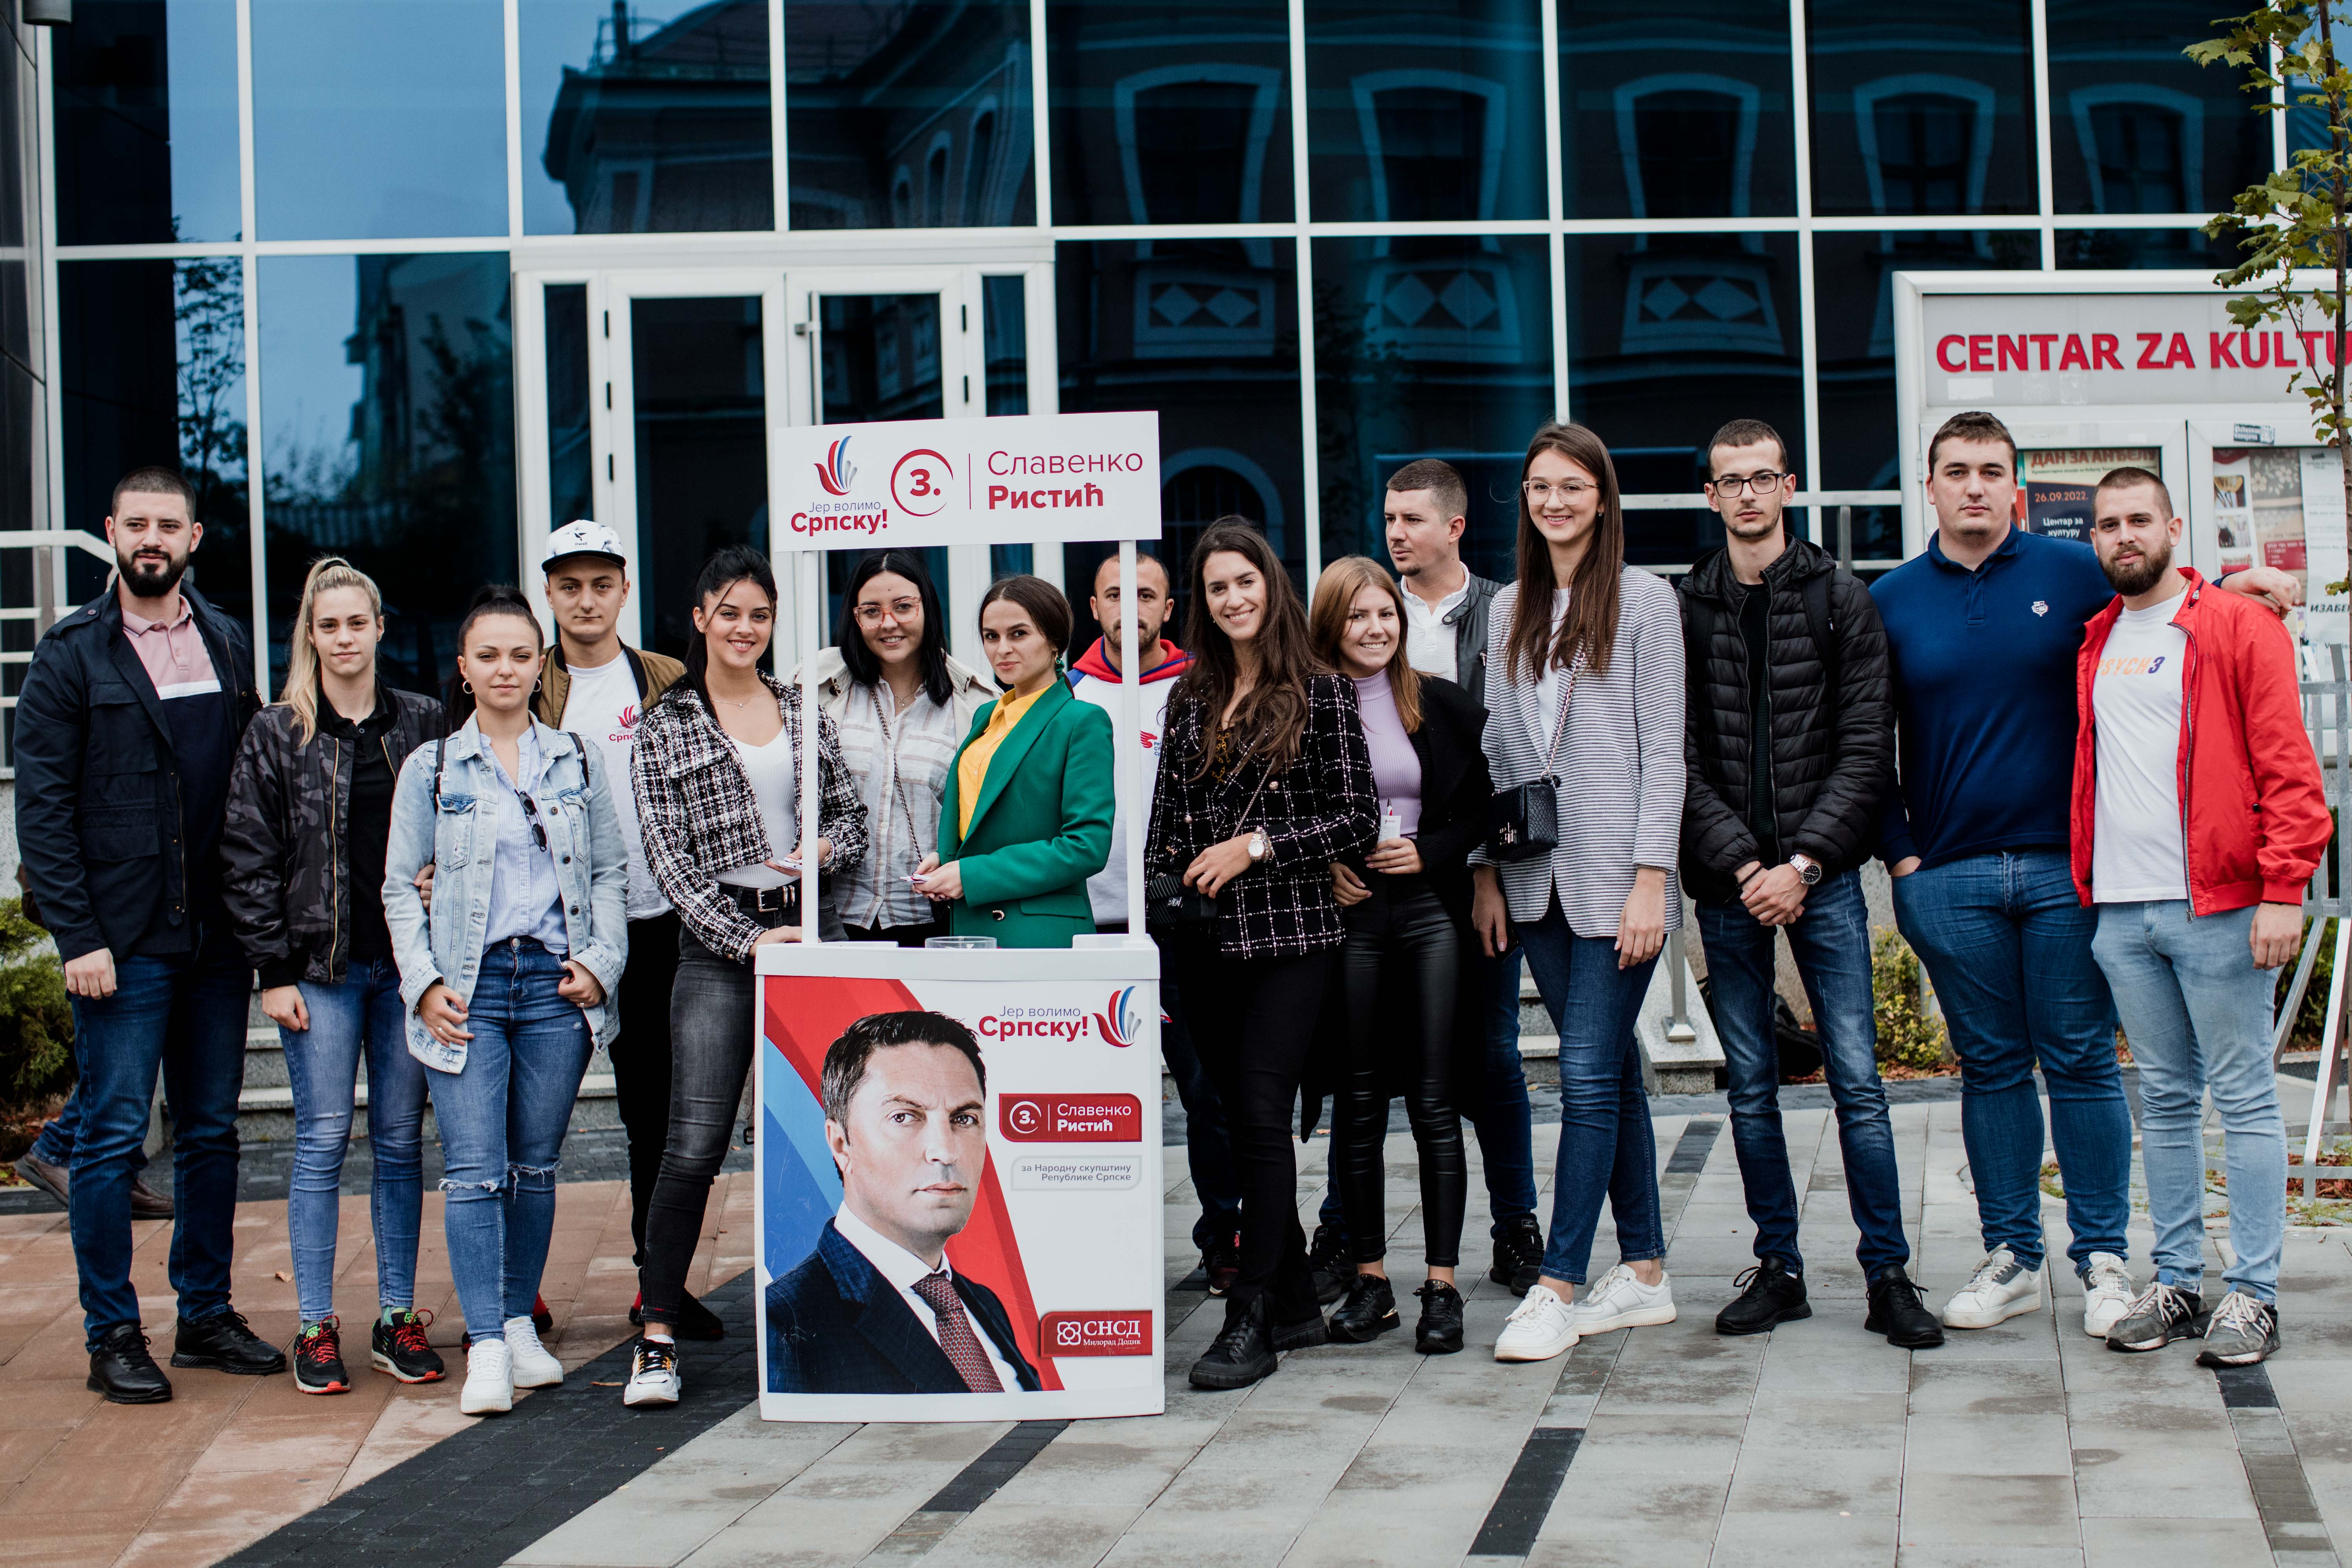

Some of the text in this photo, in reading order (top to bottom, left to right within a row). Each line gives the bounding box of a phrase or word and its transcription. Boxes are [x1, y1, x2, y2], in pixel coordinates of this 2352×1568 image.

[1937, 333, 2124, 372] CENTAR
[2137, 332, 2196, 369] ZA
[988, 451, 1143, 476] Славенко
[2031, 451, 2066, 468] ДАН
[910, 469, 941, 496] 3.
[989, 482, 1103, 510] Ристић
[2035, 491, 2089, 503] 26.09.2022.
[809, 501, 881, 514] Јер волимо
[791, 509, 888, 537] Српску!
[2043, 517, 2073, 527] Центар
[2047, 529, 2081, 538] културу
[999, 1006, 1081, 1018] Јер волимо
[978, 1016, 1088, 1042] Српску!
[1057, 1103, 1132, 1116] Славенко
[1019, 1110, 1035, 1125] 3.
[1057, 1119, 1113, 1132] Ристић
[1035, 1164, 1077, 1173] Народну
[1042, 1173, 1131, 1183] Републике Српске
[1083, 1320, 1141, 1338] СНСД
[1083, 1339, 1116, 1347] Милорад
